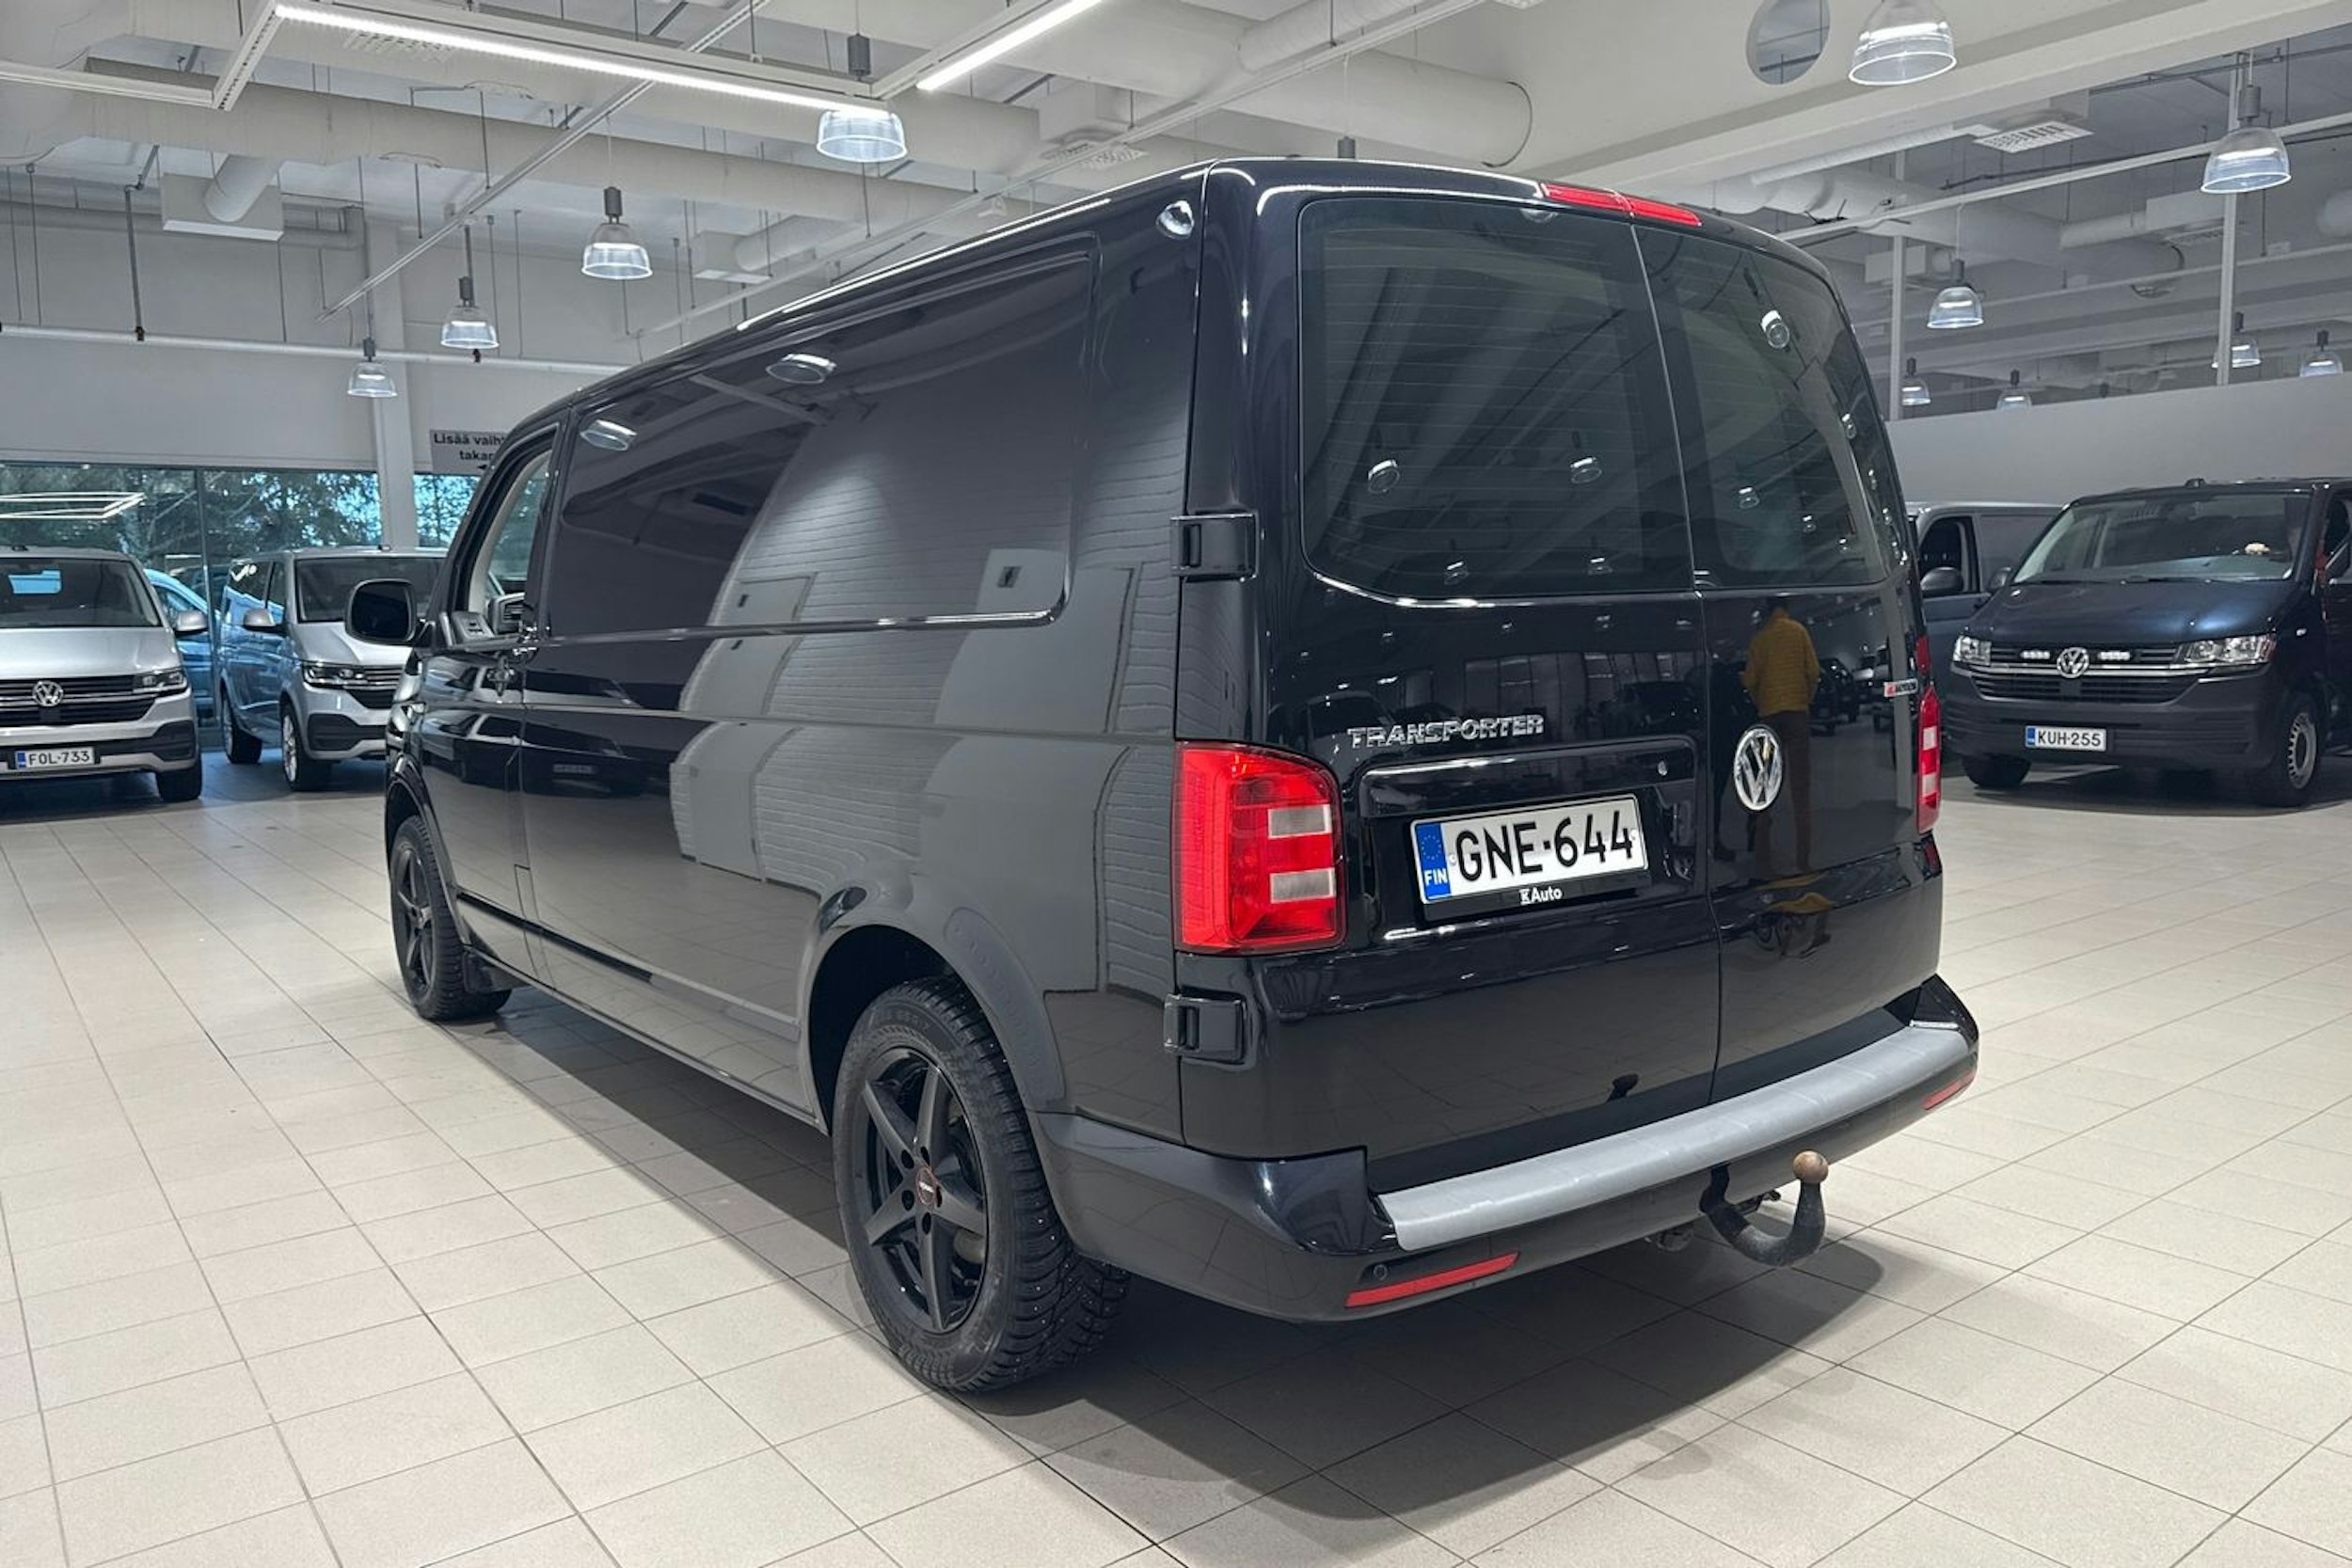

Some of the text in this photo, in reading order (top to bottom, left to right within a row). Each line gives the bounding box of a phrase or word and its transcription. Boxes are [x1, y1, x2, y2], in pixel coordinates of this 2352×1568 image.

[434, 433, 469, 445] Lisää
[459, 450, 494, 460] takar
[1347, 714, 1544, 749] TRANSPORTER
[2038, 731, 2101, 747] KUH-255
[28, 751, 90, 766] FOL-733
[1455, 810, 1632, 881] GNE-644
[1423, 867, 1448, 886] FIN
